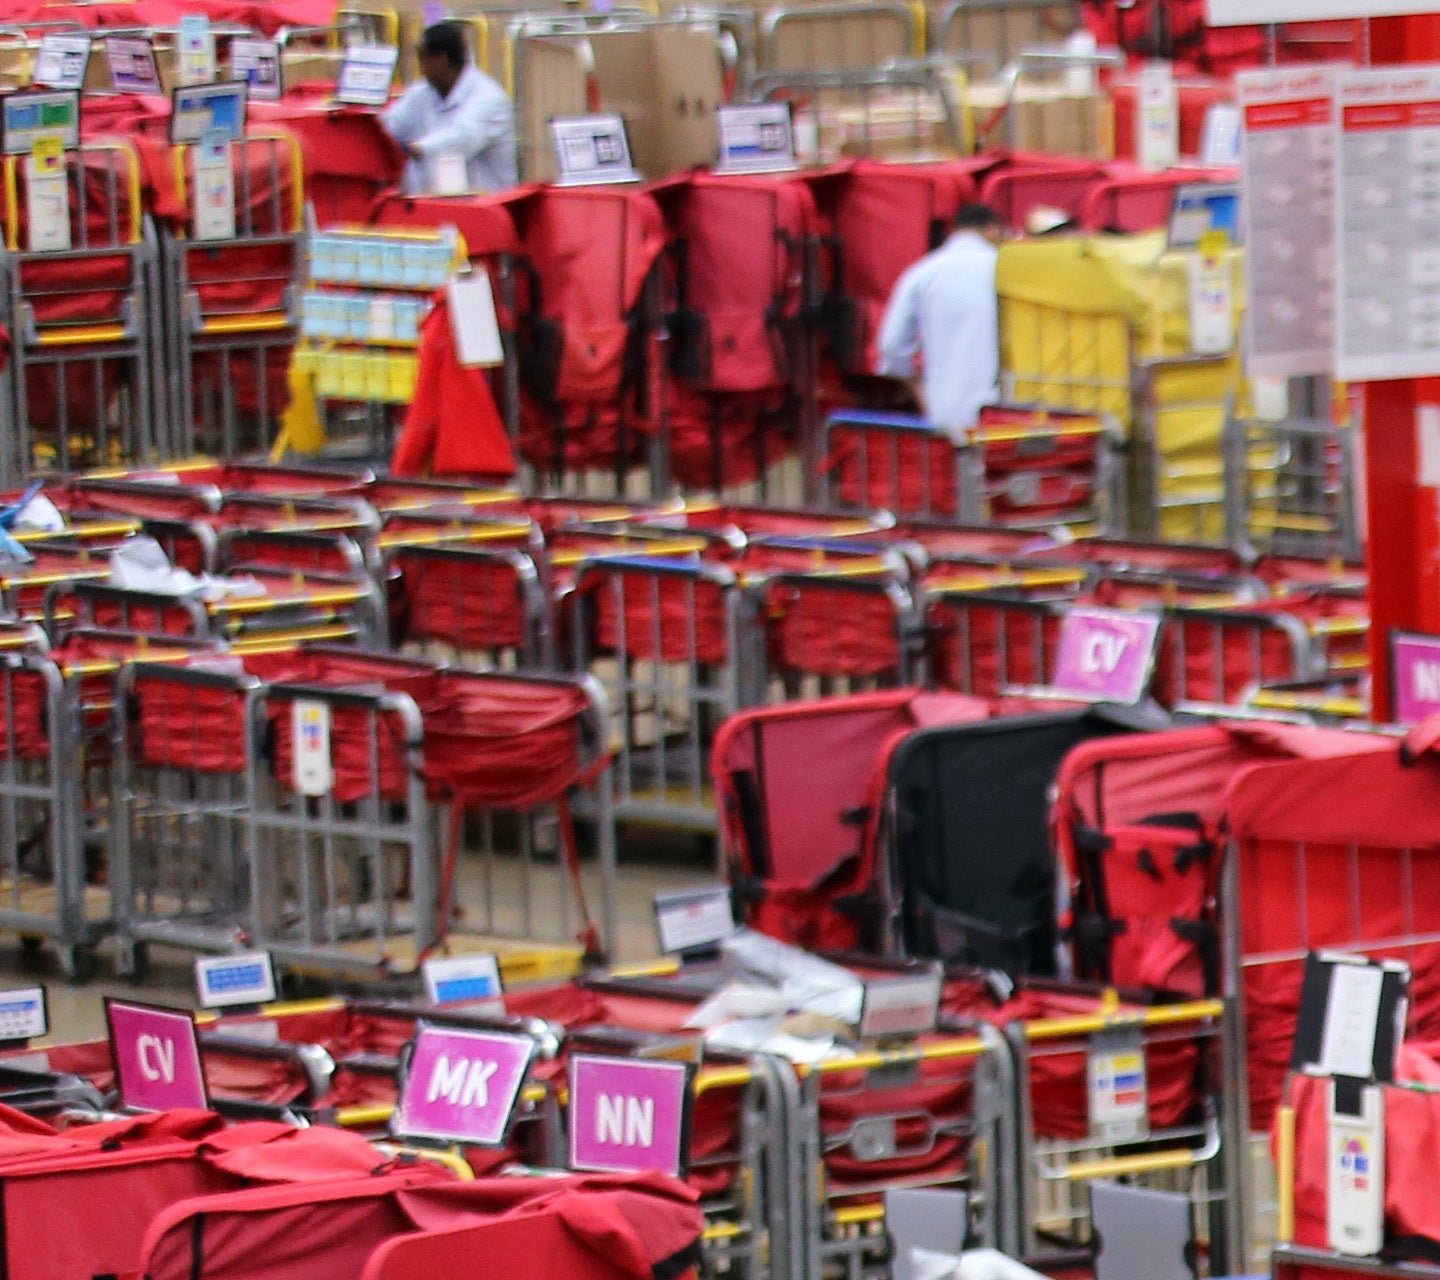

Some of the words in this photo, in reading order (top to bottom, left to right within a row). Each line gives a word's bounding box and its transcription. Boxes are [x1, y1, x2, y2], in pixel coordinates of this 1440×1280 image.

[1084, 632, 1128, 674] CV
[136, 1033, 175, 1084] CV
[427, 1054, 499, 1108] MK
[595, 1093, 654, 1147] NN
